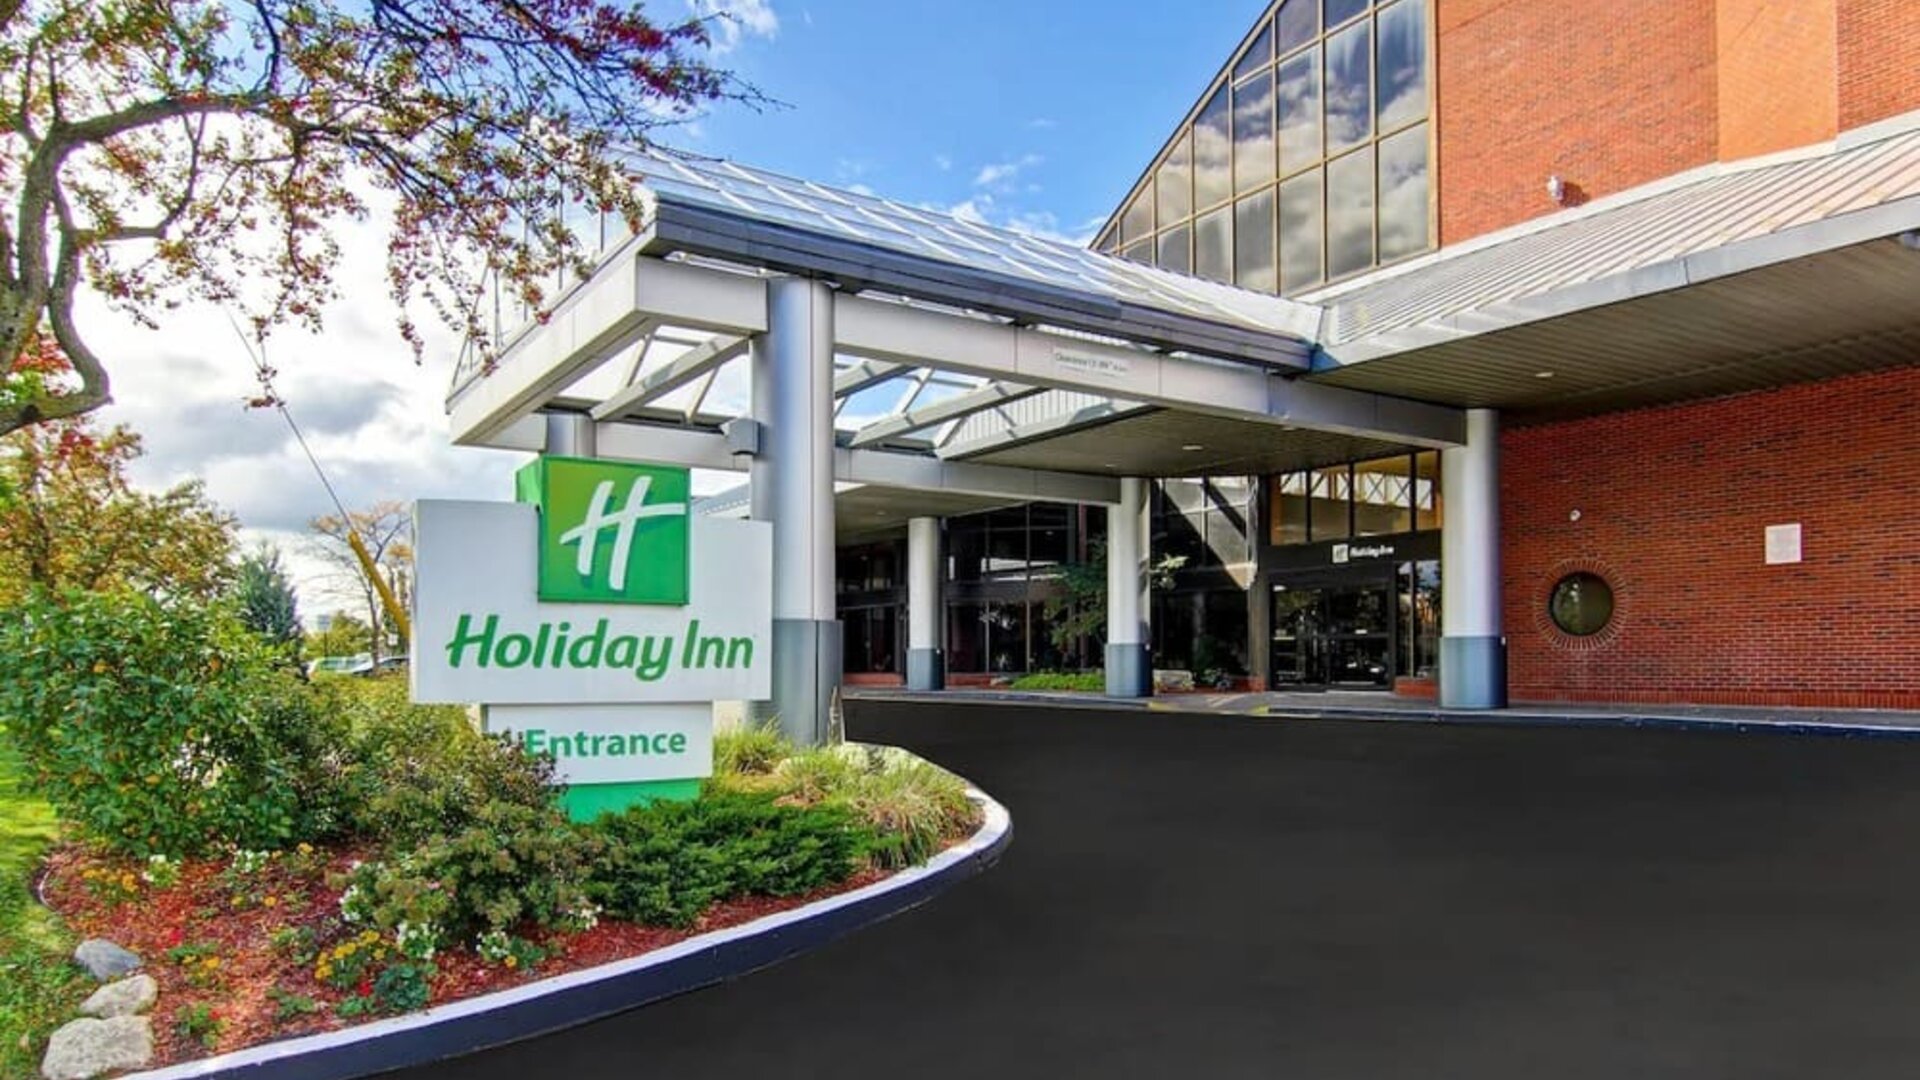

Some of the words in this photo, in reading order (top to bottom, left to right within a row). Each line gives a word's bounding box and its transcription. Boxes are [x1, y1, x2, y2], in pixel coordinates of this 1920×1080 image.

[559, 475, 686, 591] H
[445, 614, 673, 682] Holiday
[681, 619, 754, 669] Inn
[525, 729, 687, 758] Entrance
